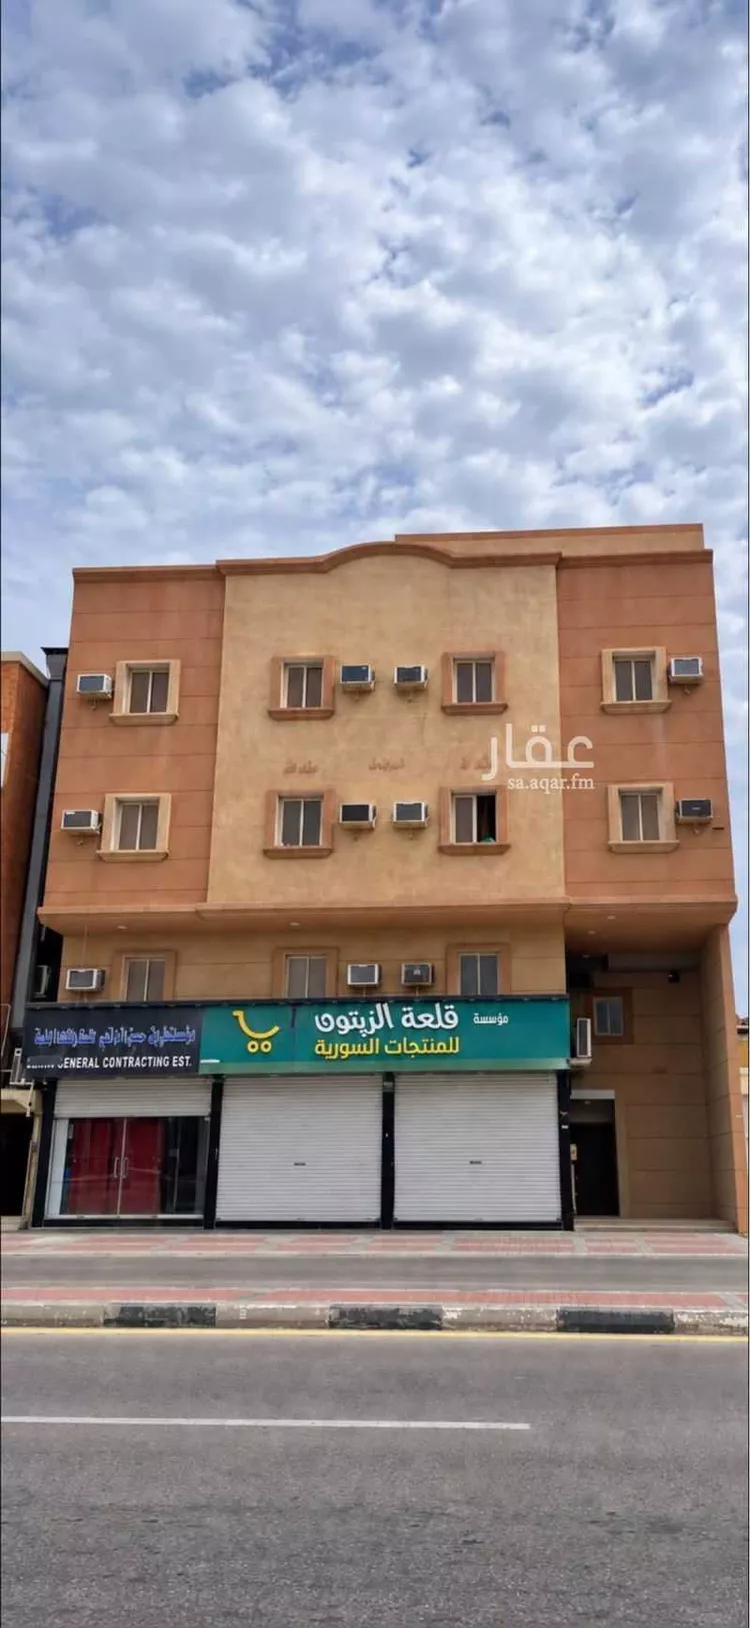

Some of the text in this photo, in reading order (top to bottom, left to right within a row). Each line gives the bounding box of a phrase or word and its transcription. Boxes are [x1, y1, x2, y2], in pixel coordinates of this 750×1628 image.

[401, 1003, 459, 1030] قلعة
[473, 1012, 509, 1026] مؤسسة
[314, 1036, 460, 1060] للمنتجات السورية
[102, 1056, 170, 1068] CONTRACTING
[172, 1055, 192, 1067] EST.
